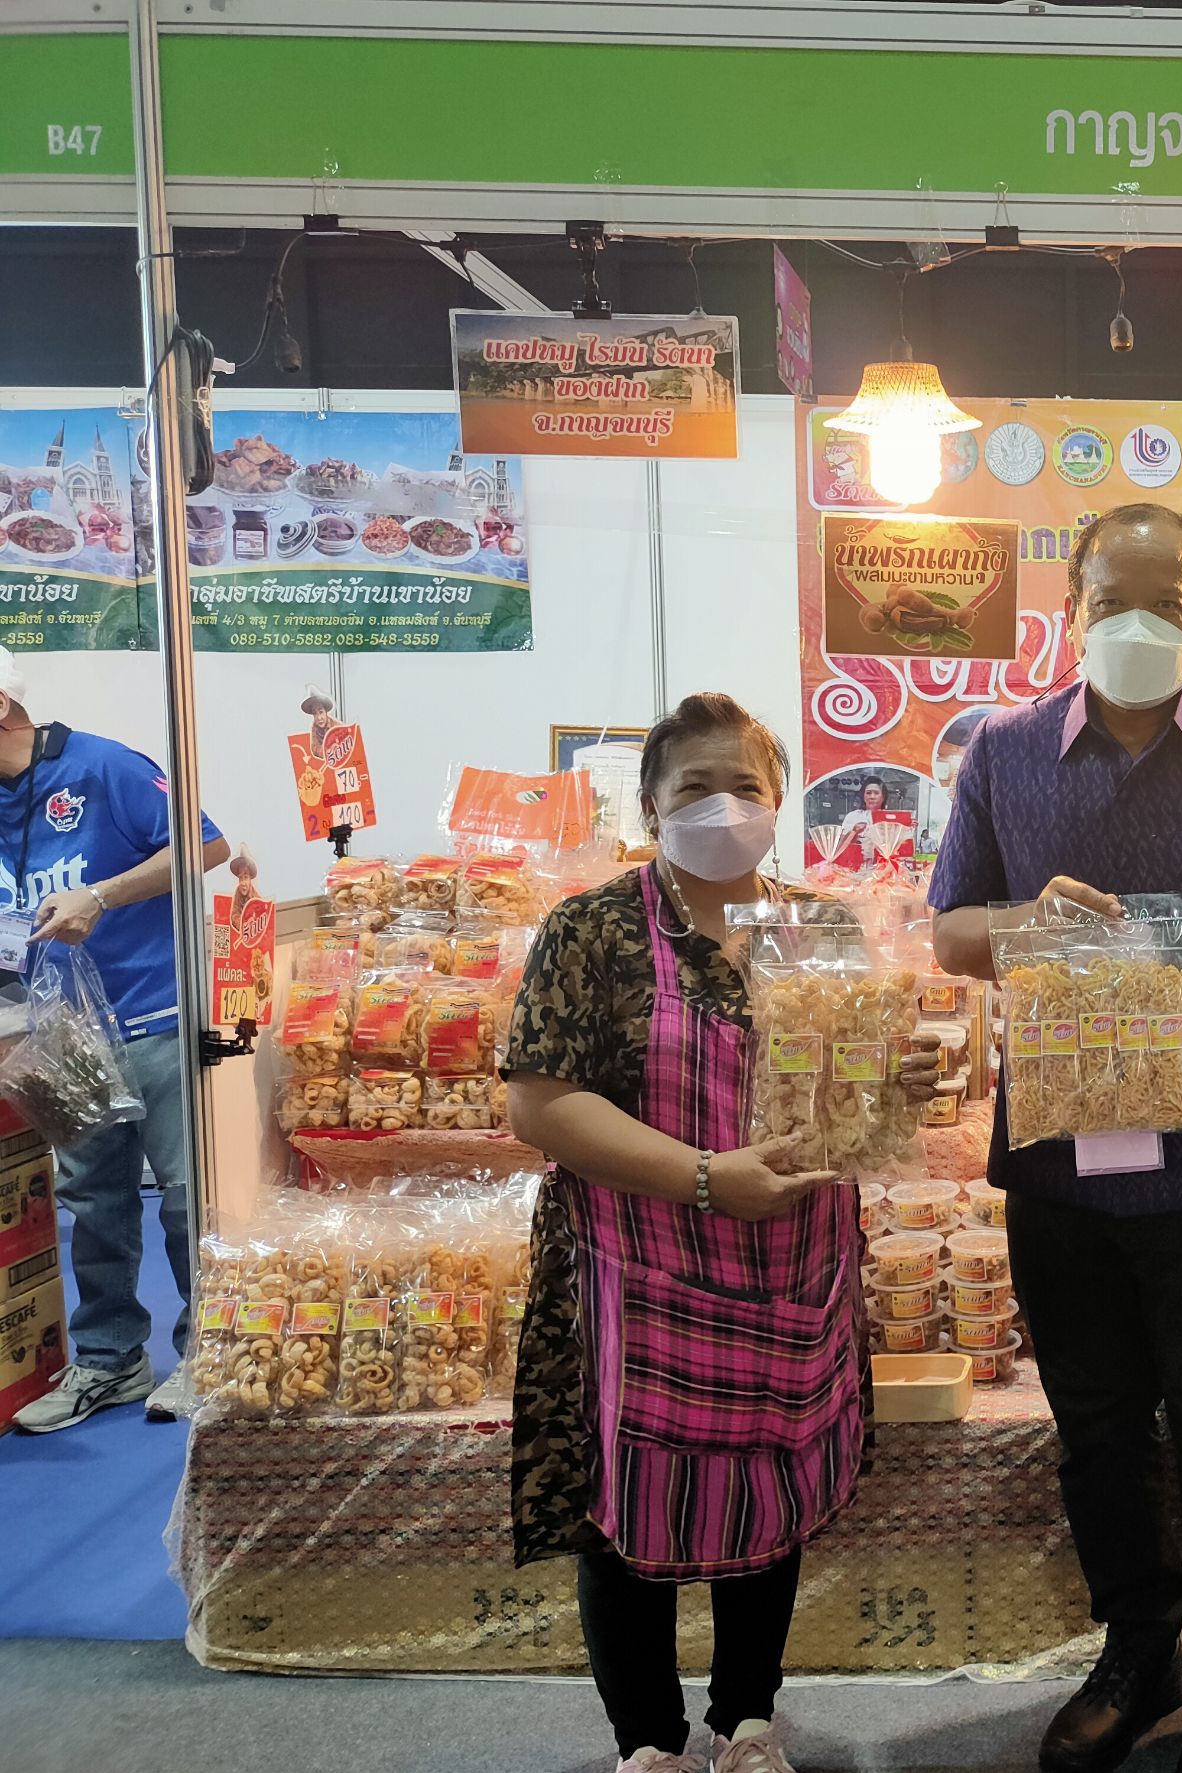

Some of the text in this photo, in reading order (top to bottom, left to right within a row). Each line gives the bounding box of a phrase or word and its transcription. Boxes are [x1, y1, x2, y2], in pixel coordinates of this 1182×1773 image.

[47, 124, 103, 156] B47
[484, 337, 577, 371] แคปหมู
[653, 336, 716, 366] รัตนา
[556, 374, 649, 399] ของฝาก
[533, 410, 673, 445] จ.กาญจนบุรี
[222, 614, 246, 626] 4/3
[272, 614, 280, 625] 7
[338, 769, 355, 793] 70
[26, 853, 88, 911] ptt
[223, 988, 248, 1020] 120
[0, 1297, 38, 1333] ESCAFÉ
